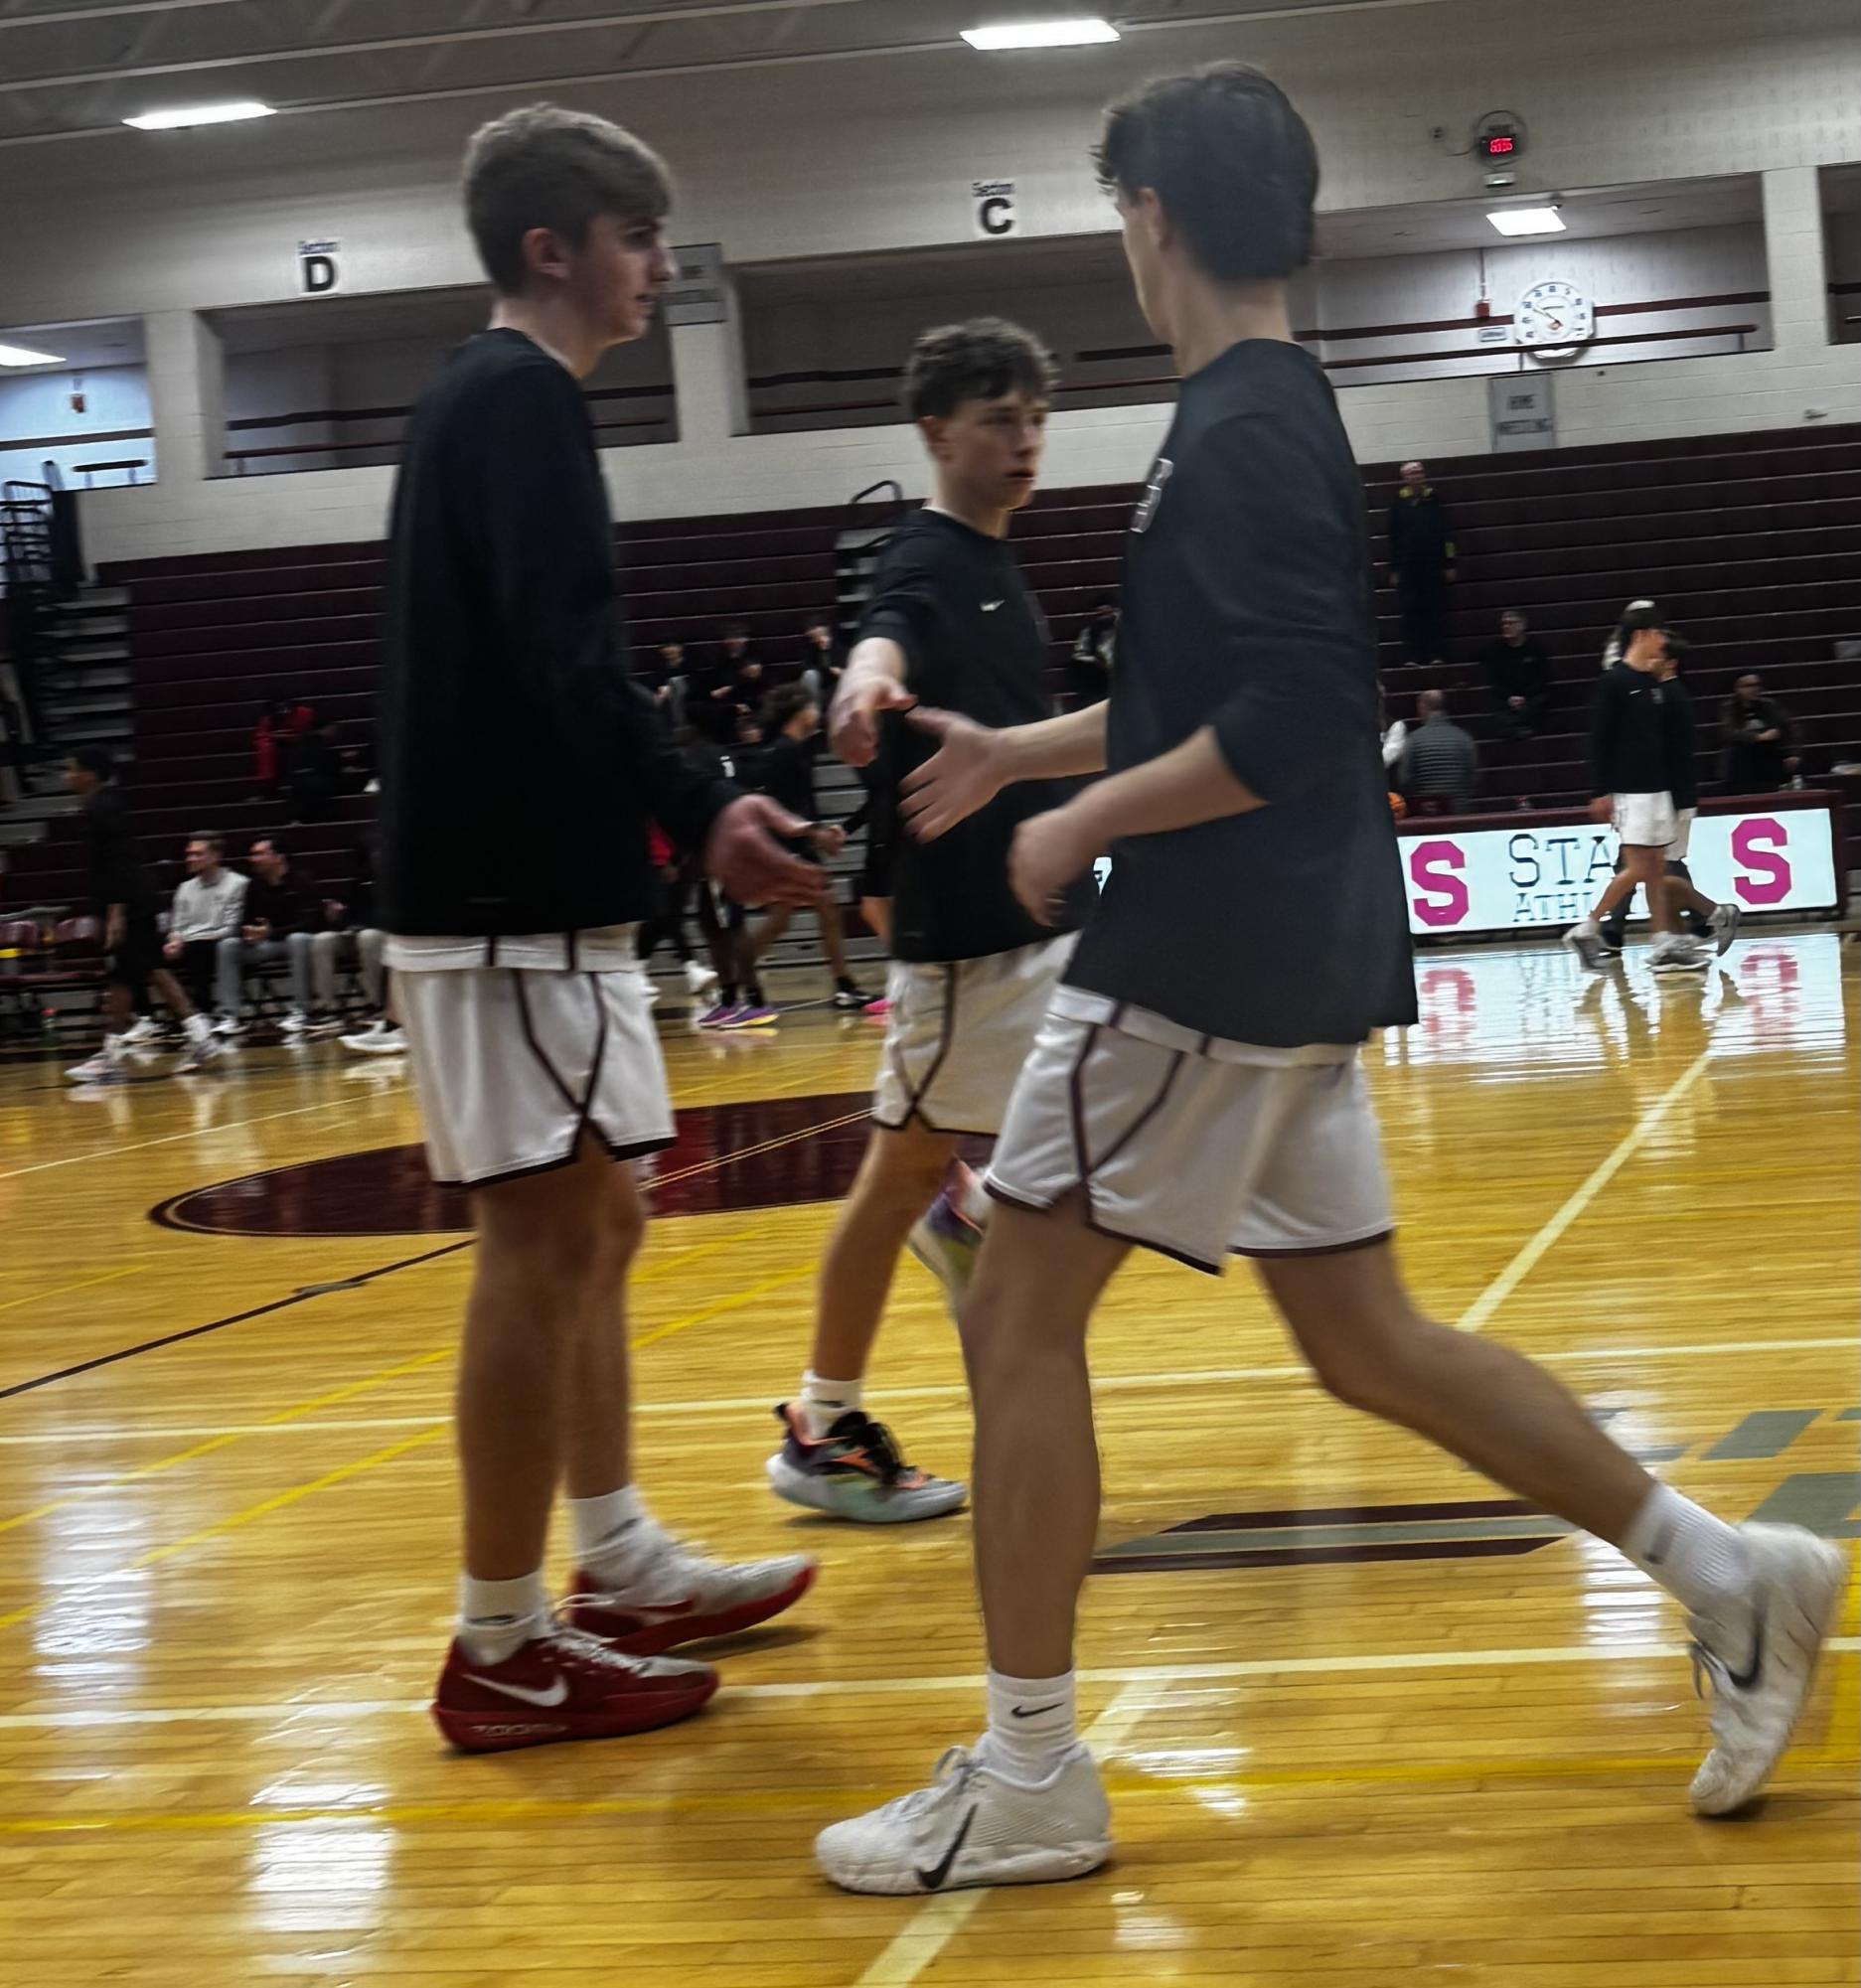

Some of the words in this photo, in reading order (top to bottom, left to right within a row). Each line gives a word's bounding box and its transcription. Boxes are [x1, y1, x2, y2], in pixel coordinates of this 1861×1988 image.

[979, 197, 1014, 235] C
[302, 255, 338, 293] D
[1410, 841, 1470, 926] S
[1508, 834, 1616, 888] STA
[1731, 818, 1792, 905] S
